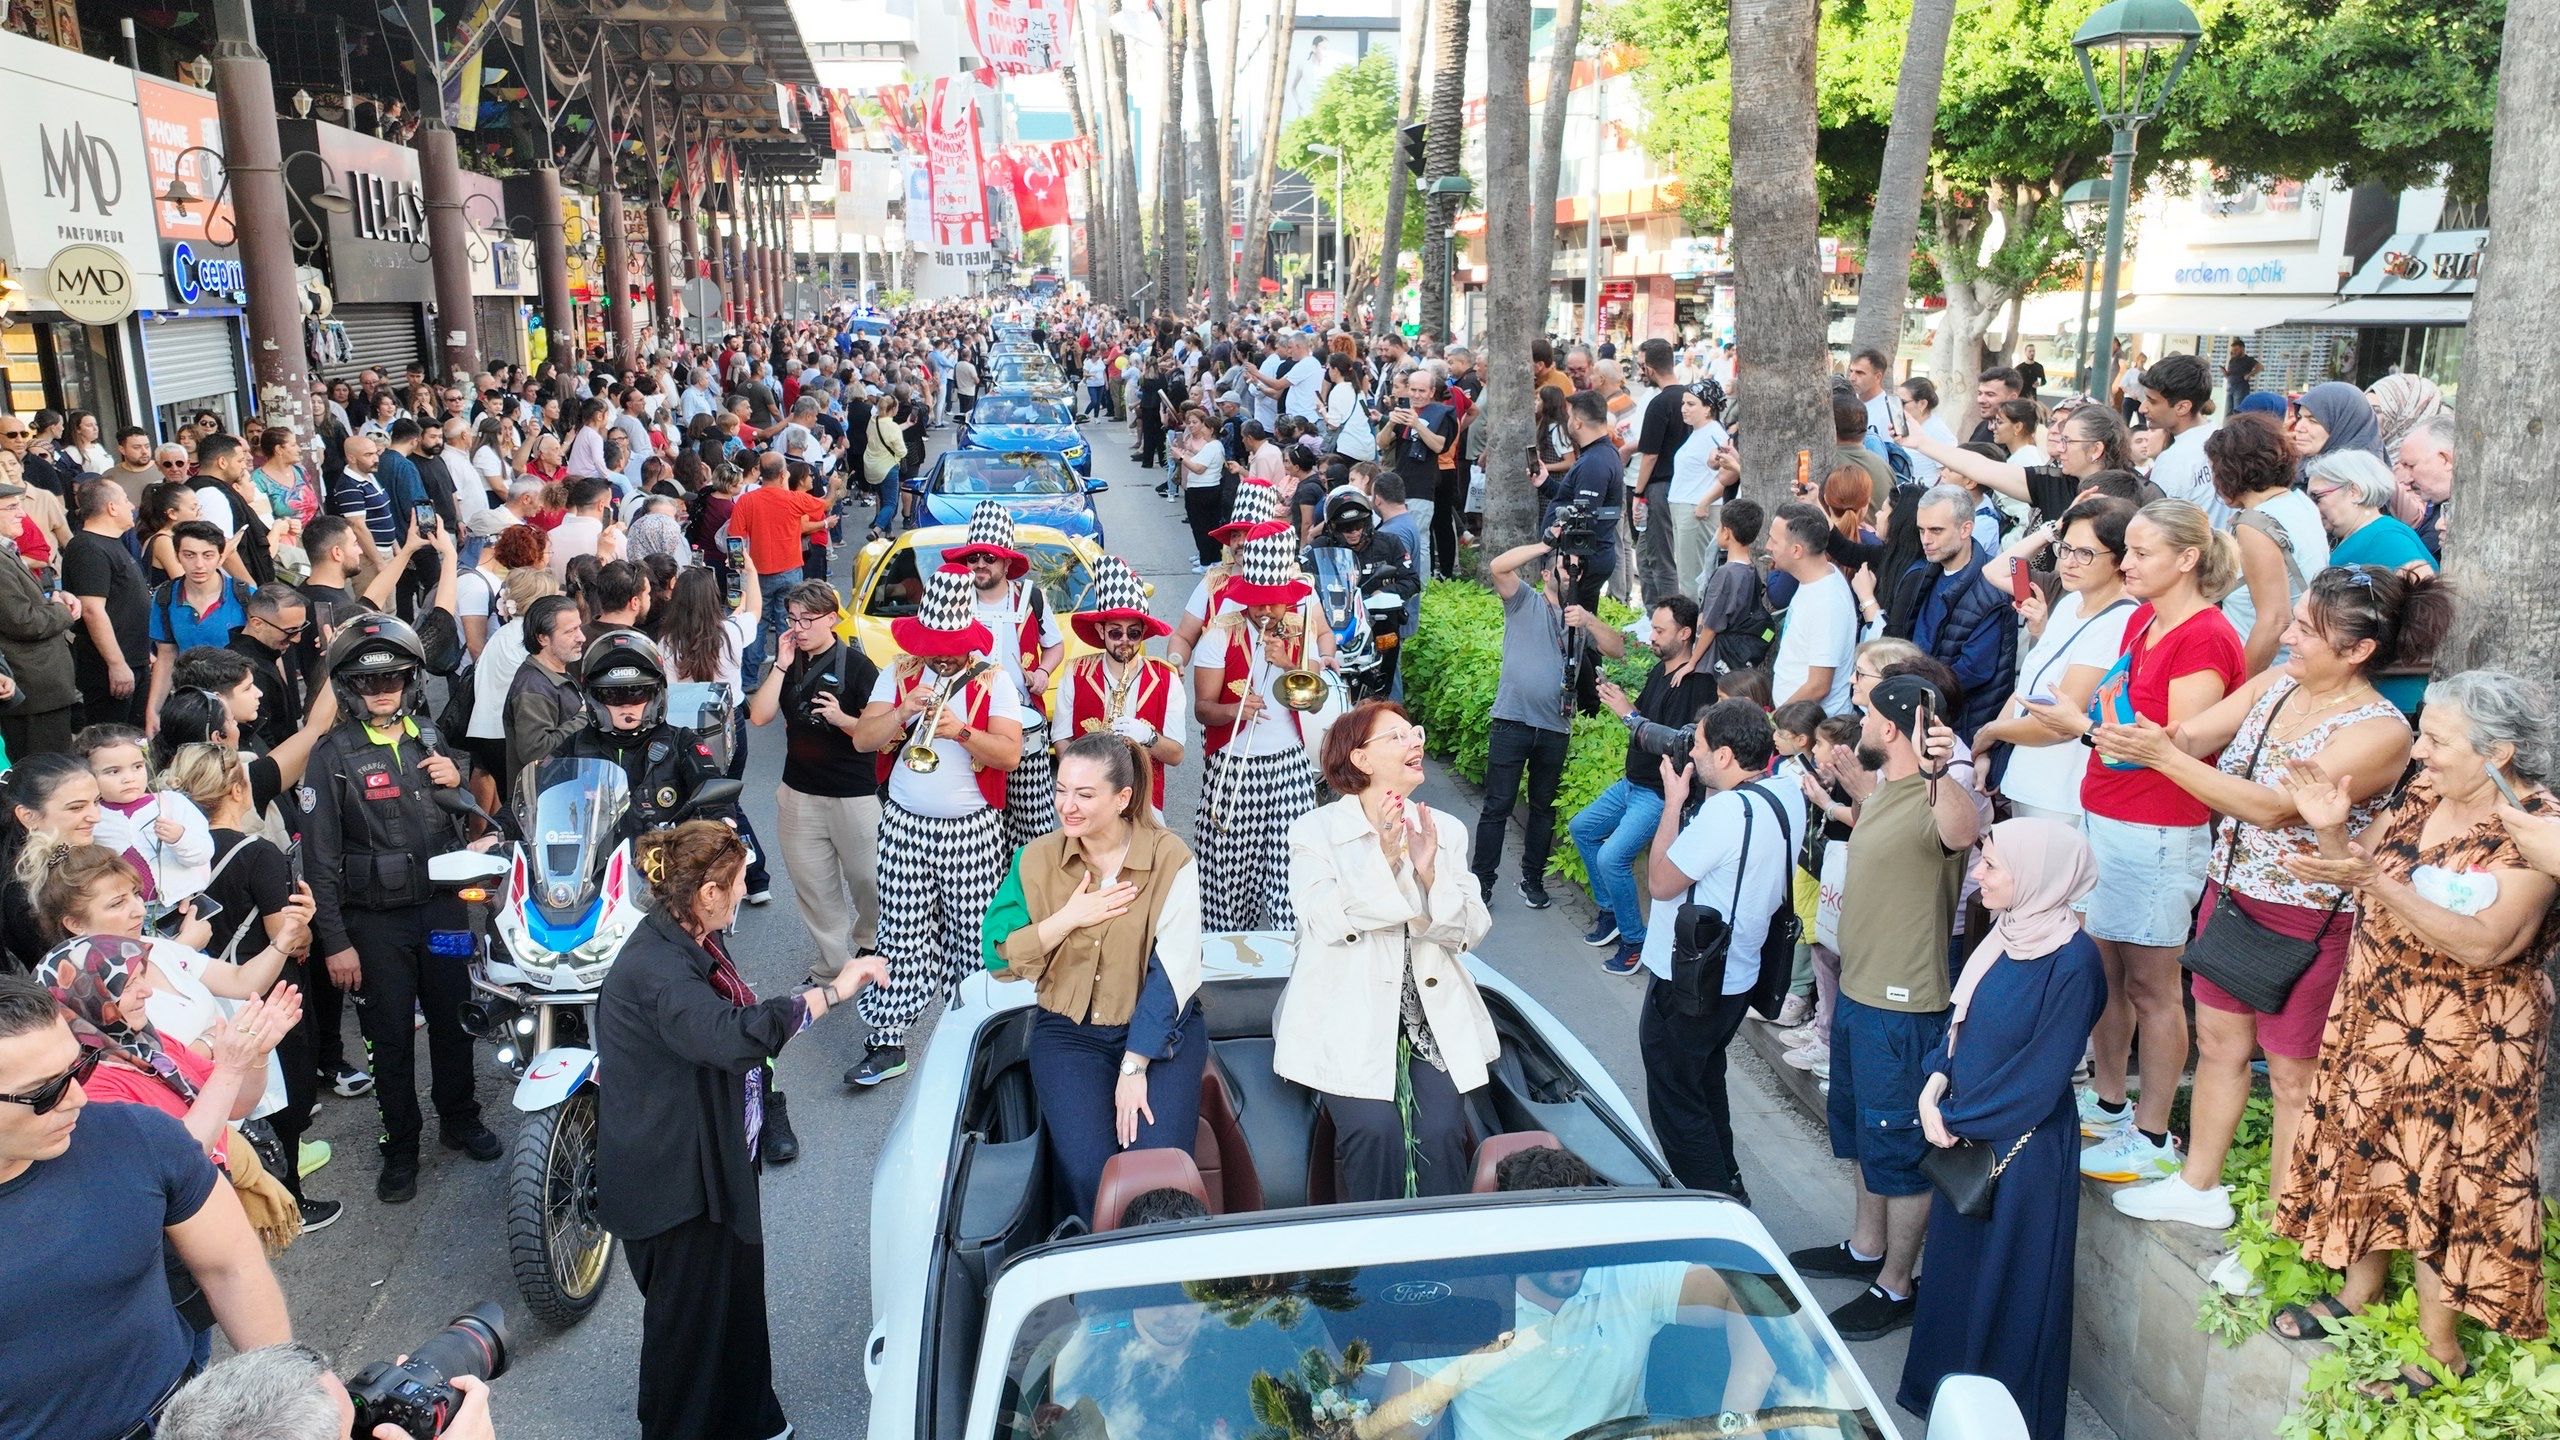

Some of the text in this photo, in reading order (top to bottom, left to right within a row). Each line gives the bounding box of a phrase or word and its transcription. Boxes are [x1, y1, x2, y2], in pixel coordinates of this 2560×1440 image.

[146, 118, 190, 147] PHONE
[39, 120, 122, 217] MAD
[150, 148, 196, 178] TABLET
[58, 225, 124, 243] PARFUMEUR
[57, 265, 124, 296] MAD
[2175, 260, 2284, 288] erdem optik
[363, 653, 390, 663] SHOEI
[613, 668, 636, 677] SHOEI
[1394, 1284, 1439, 1301] Ford
